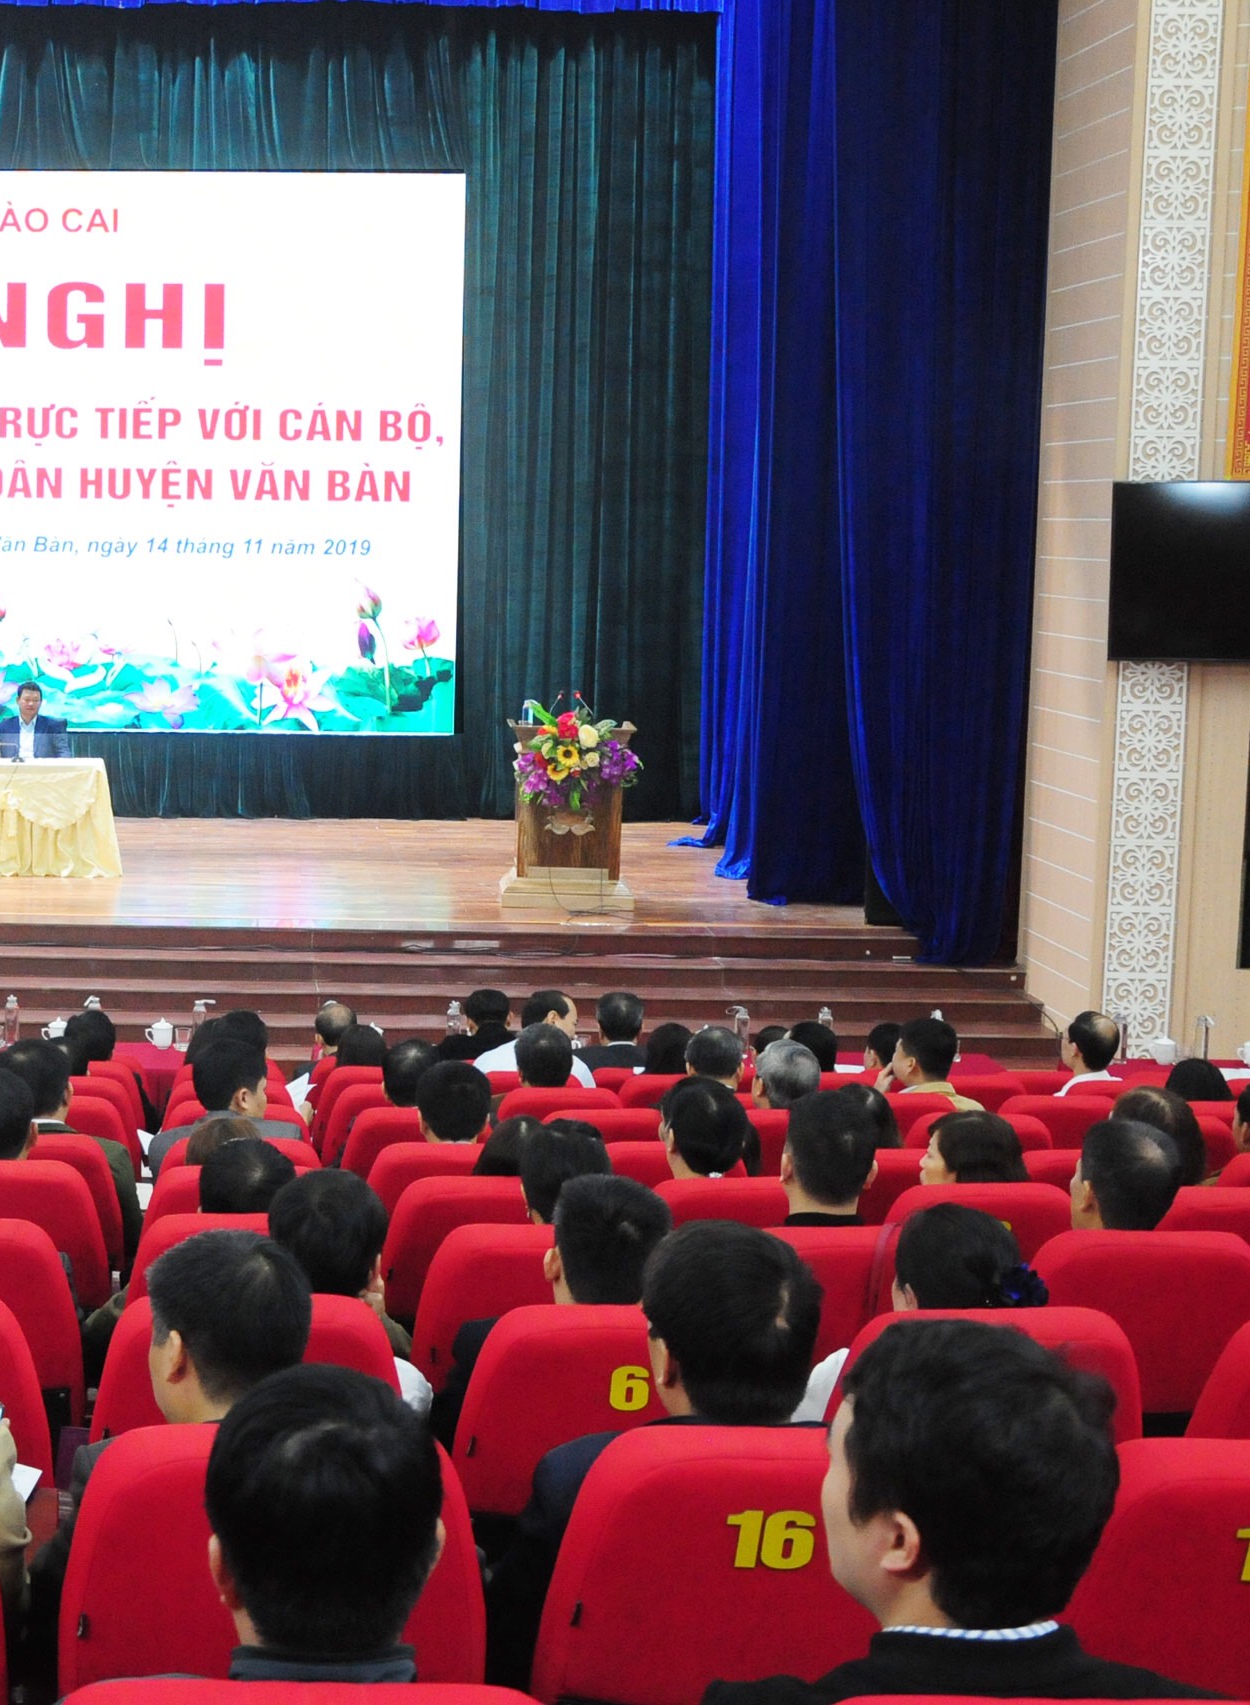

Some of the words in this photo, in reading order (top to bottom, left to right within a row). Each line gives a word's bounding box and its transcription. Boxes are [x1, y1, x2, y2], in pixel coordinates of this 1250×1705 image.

[61, 208, 119, 233] CAI
[94, 396, 182, 440] TIẾP
[198, 401, 262, 441] VỚI
[278, 402, 362, 442] CÁN
[379, 403, 444, 450] BỘ,
[79, 461, 213, 507] HUYỆN
[229, 462, 310, 502] VĂN
[327, 463, 412, 503] BÀN
[87, 537, 138, 558] ngày
[147, 537, 169, 553] 14
[176, 537, 235, 559] tháng
[244, 538, 263, 554] 11
[271, 539, 316, 555] năm
[323, 539, 372, 556] 2019
[609, 1365, 650, 1411] 6
[727, 1509, 816, 1570] 16
